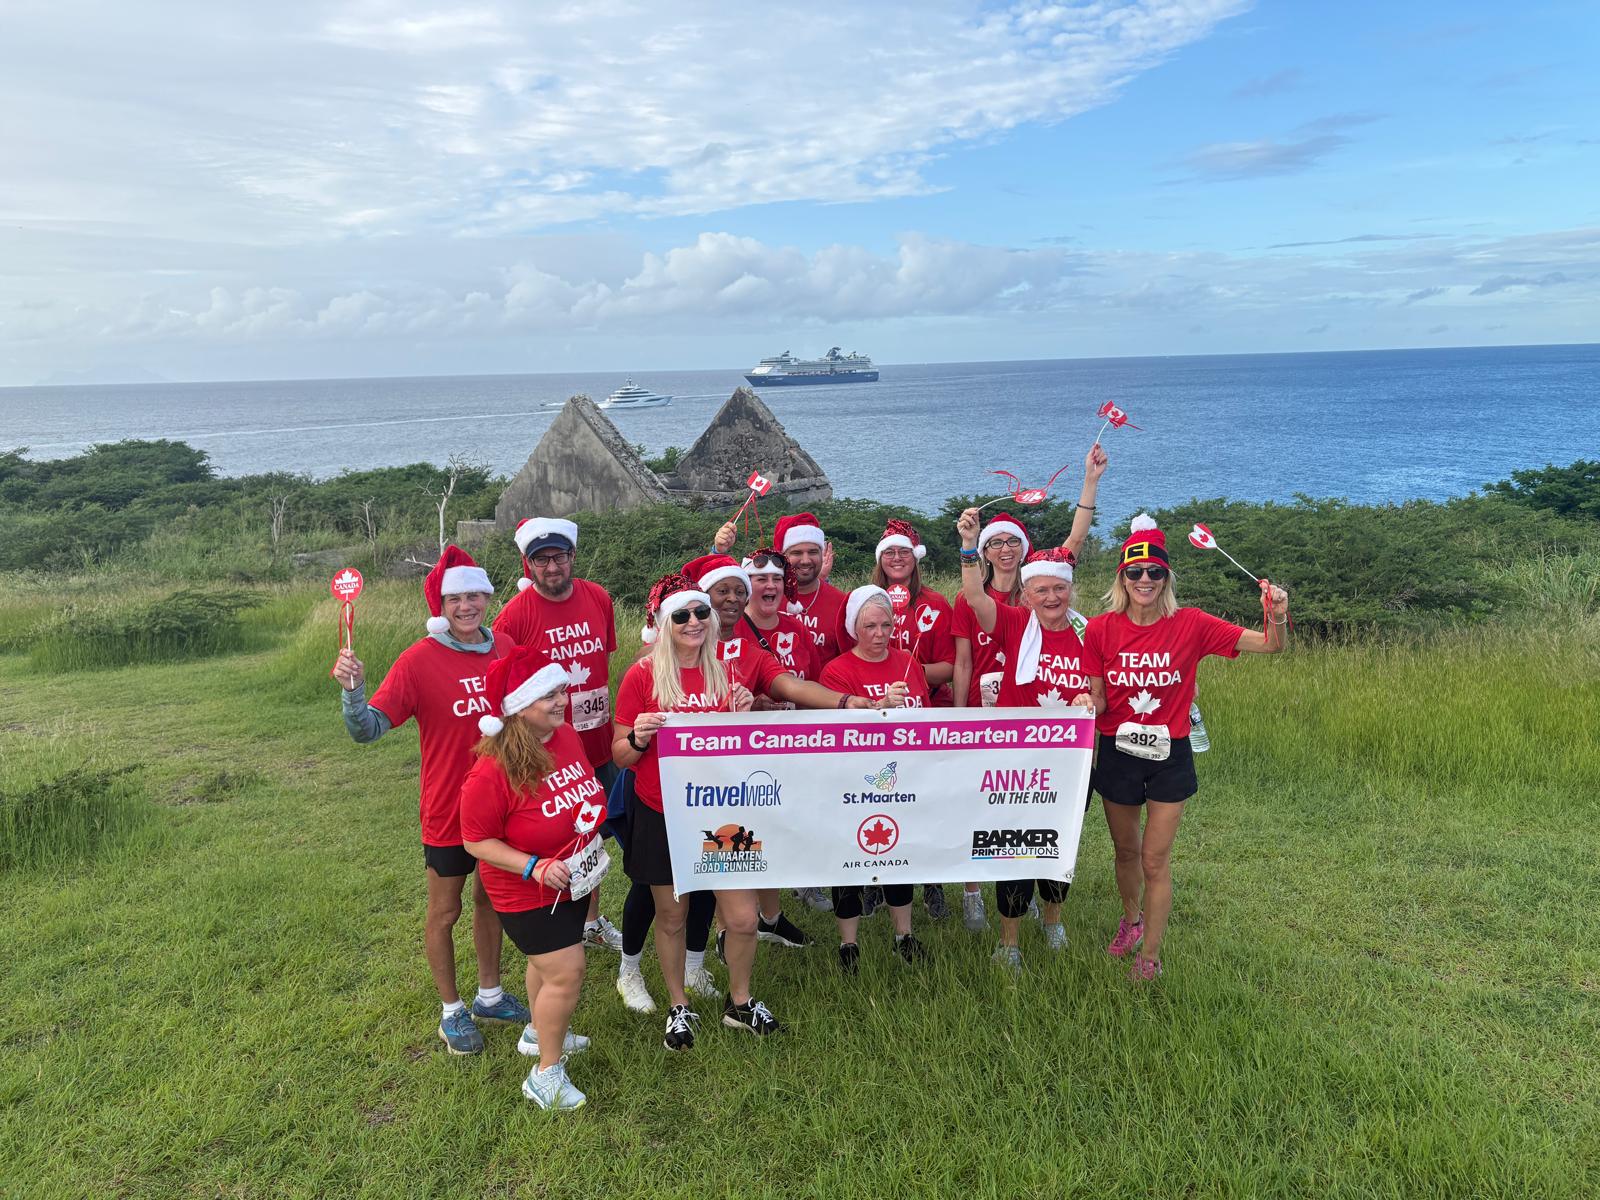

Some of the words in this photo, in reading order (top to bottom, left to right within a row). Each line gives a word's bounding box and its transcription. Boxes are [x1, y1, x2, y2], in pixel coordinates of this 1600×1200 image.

[334, 582, 360, 591] CANADA
[545, 621, 591, 644] TEAM
[541, 637, 604, 661] ANADA
[1118, 652, 1171, 669] TEAM
[1107, 669, 1182, 688] CANADA
[583, 696, 605, 715] 345
[675, 732, 742, 751] Team
[748, 729, 836, 749] Canada
[843, 728, 886, 747] Run
[892, 728, 922, 746] St.
[929, 725, 1018, 745] Maarten
[1024, 724, 1077, 743] 2024
[1130, 732, 1158, 748] 392
[542, 761, 587, 792] TEAM
[685, 779, 782, 807] travelweek
[988, 792, 1007, 805] ON
[1008, 791, 1031, 805] THE
[1031, 791, 1058, 804] RUN
[972, 828, 1059, 849] BARKER
[580, 850, 599, 878] 383
[717, 850, 763, 862] MAARTEN
[842, 861, 861, 869] AIR
[863, 859, 909, 868] CANADA
[693, 862, 721, 875] ROAD
[722, 860, 767, 873] RUNNERS
